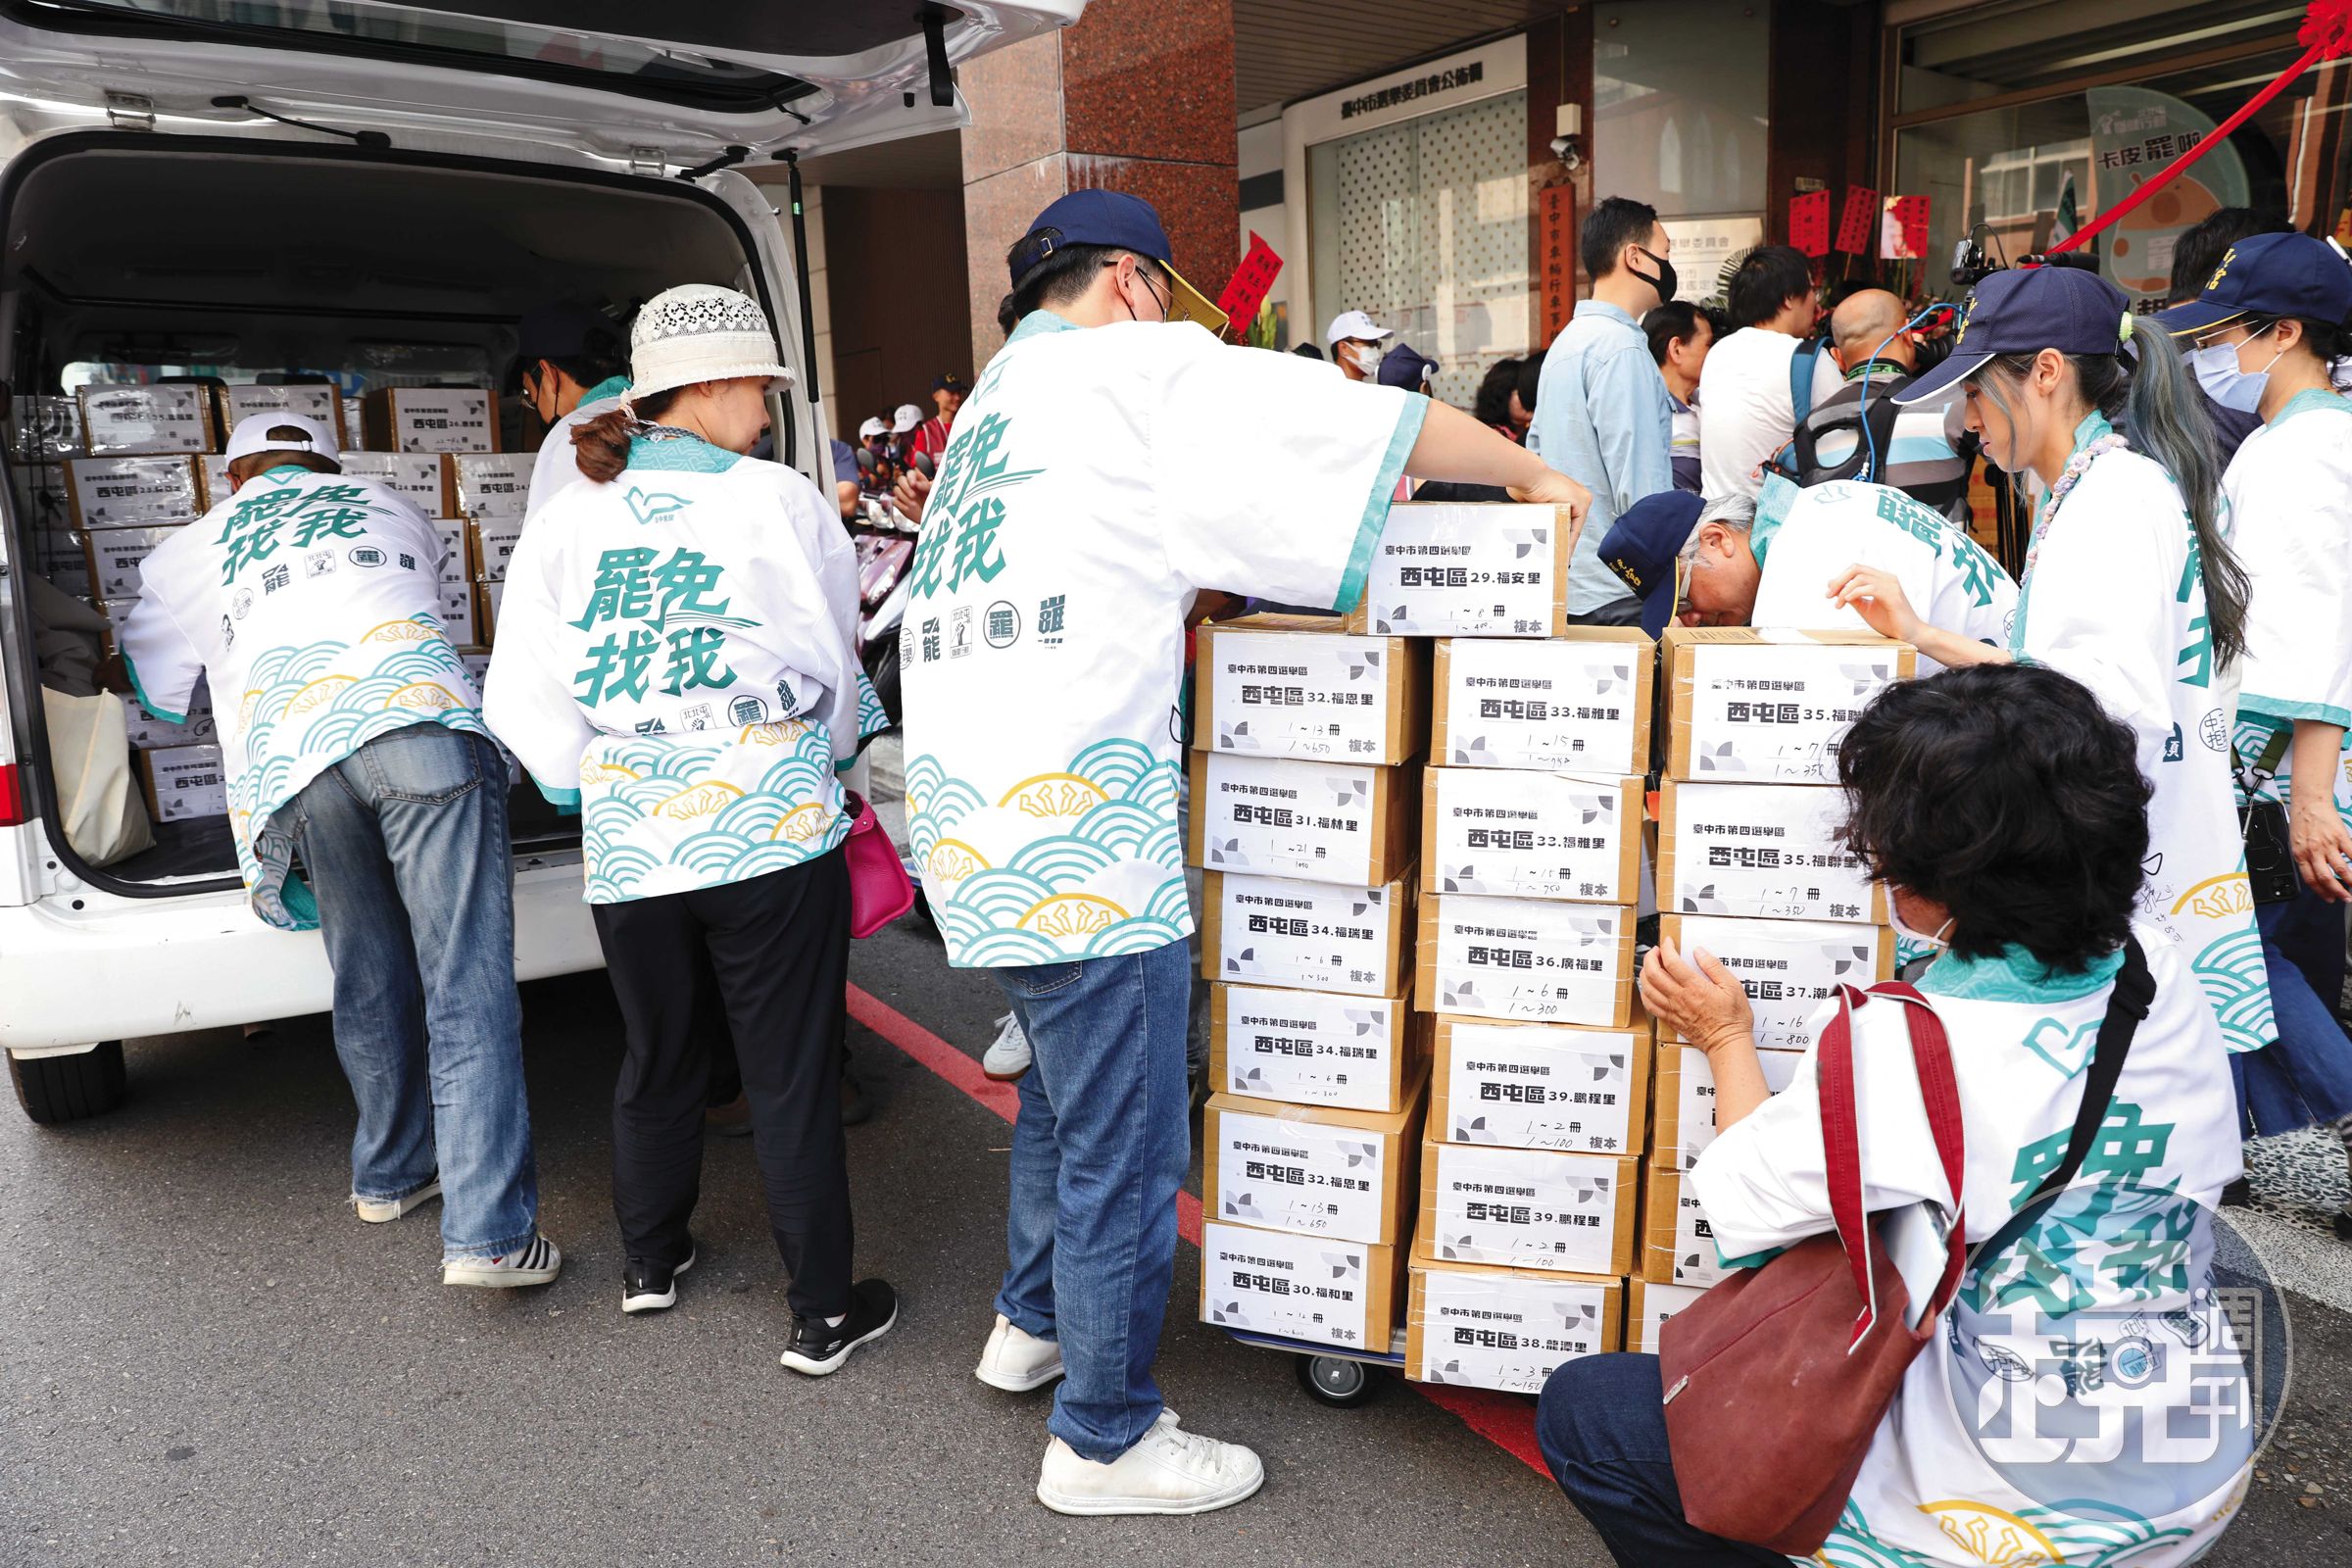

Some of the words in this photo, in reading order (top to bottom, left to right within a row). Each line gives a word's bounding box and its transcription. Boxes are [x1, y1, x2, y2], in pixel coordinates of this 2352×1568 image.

[920, 412, 1012, 531] 罷免
[213, 485, 371, 545] 罷免
[221, 509, 368, 587] 找我
[910, 497, 1006, 600] 找我
[1385, 546, 1471, 556] 臺中市第四選舉區
[566, 547, 732, 635] 罷免
[1514, 619, 1542, 633] 複本
[571, 626, 738, 710] 找我
[1228, 664, 1307, 675] 臺中市第四選舉區
[1466, 677, 1552, 689] 臺中市第四選舉區
[1349, 739, 1376, 753] 複本
[1221, 783, 1298, 800] 臺中市第四選舉區
[1453, 808, 1538, 820] 臺中市第四選舉區
[1693, 823, 1786, 837] 臺中市第四選舉區
[1580, 883, 1607, 897] 複本
[1236, 895, 1312, 909] 臺中市第四選舉區
[1830, 904, 1860, 918] 複本
[1454, 924, 1537, 940] 臺中市第四選舉區
[1349, 970, 1376, 983] 複本
[1242, 1016, 1317, 1030] 臺中市第四選舉區
[1466, 1061, 1550, 1075] 臺中市第四選舉區
[1233, 1141, 1308, 1158] 臺中市第四選舉區
[1590, 1136, 1617, 1150] 複本
[1453, 1182, 1536, 1197] 臺中市第四選舉區
[1220, 1252, 1294, 1270] 臺中市第四選舉區
[1441, 1307, 1523, 1323] 臺中市第四選舉區
[1332, 1327, 1355, 1341] 複本
